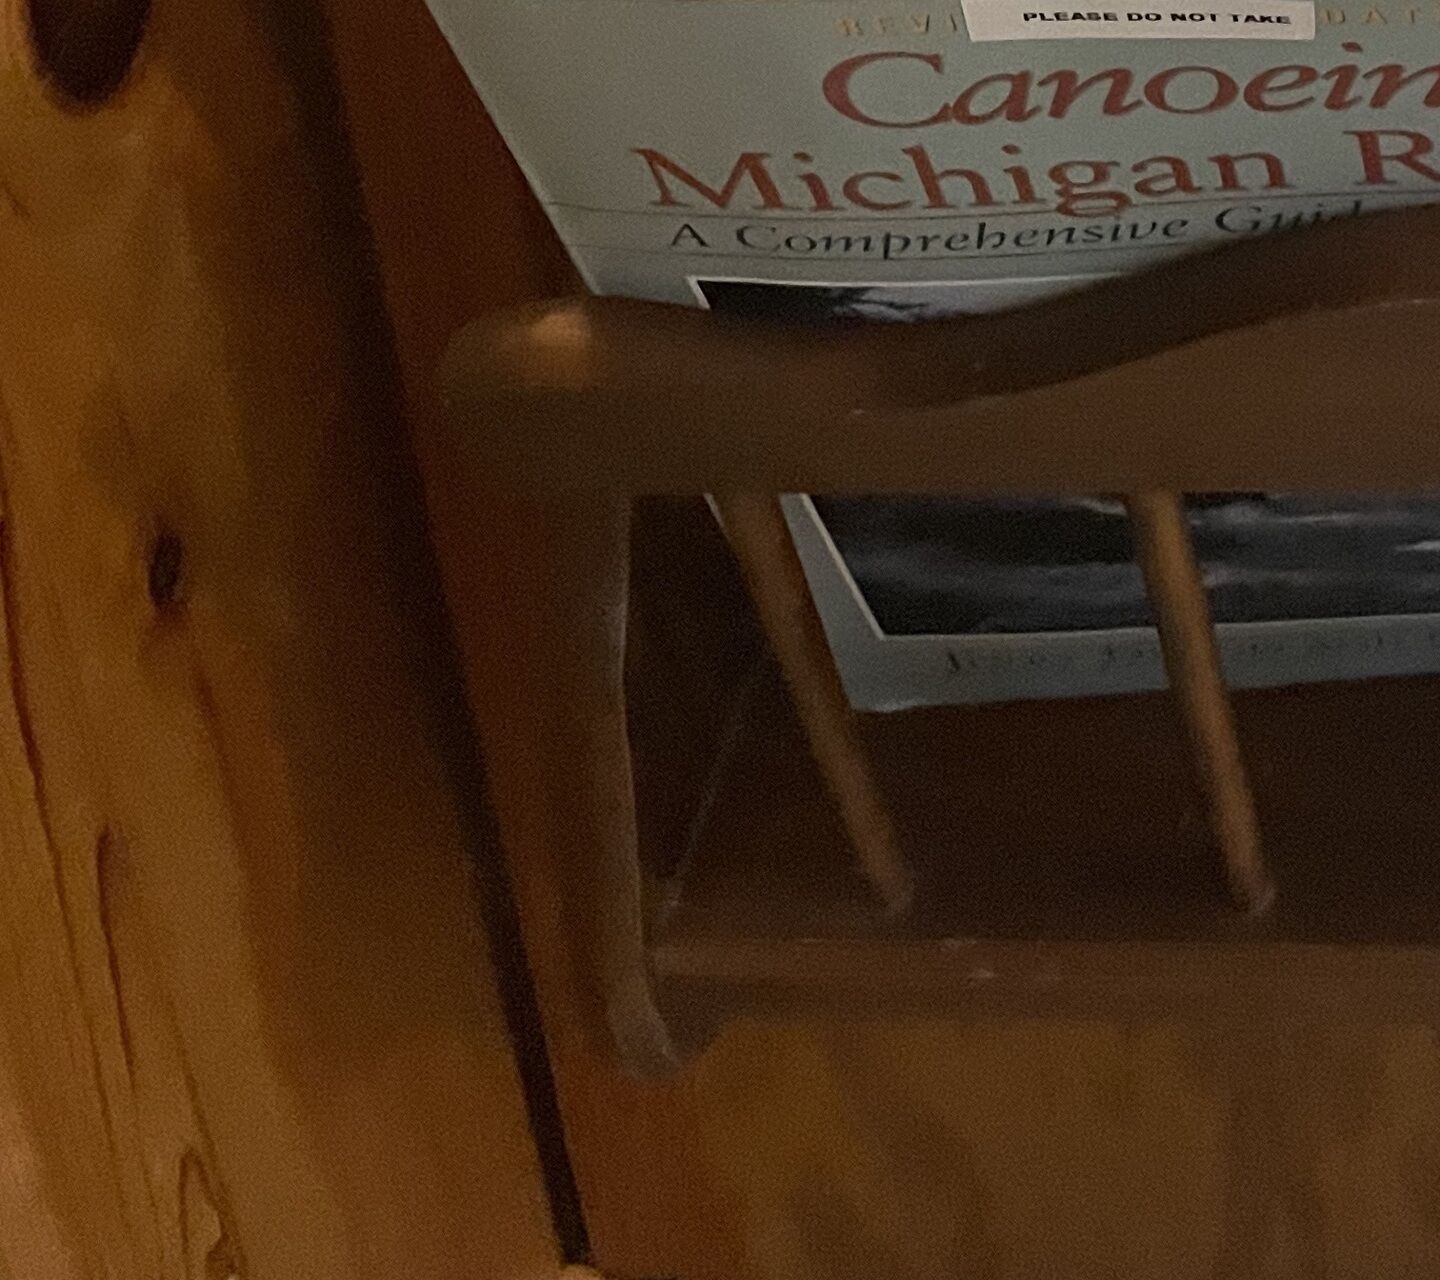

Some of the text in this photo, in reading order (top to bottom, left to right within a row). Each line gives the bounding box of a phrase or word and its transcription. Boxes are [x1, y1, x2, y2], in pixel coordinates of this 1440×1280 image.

[1021, 9, 1292, 26] PLEASE DO NOT TAKE
[629, 143, 1291, 219] Michigan
[669, 221, 711, 249] A
[735, 214, 1191, 262] Comprehensive
